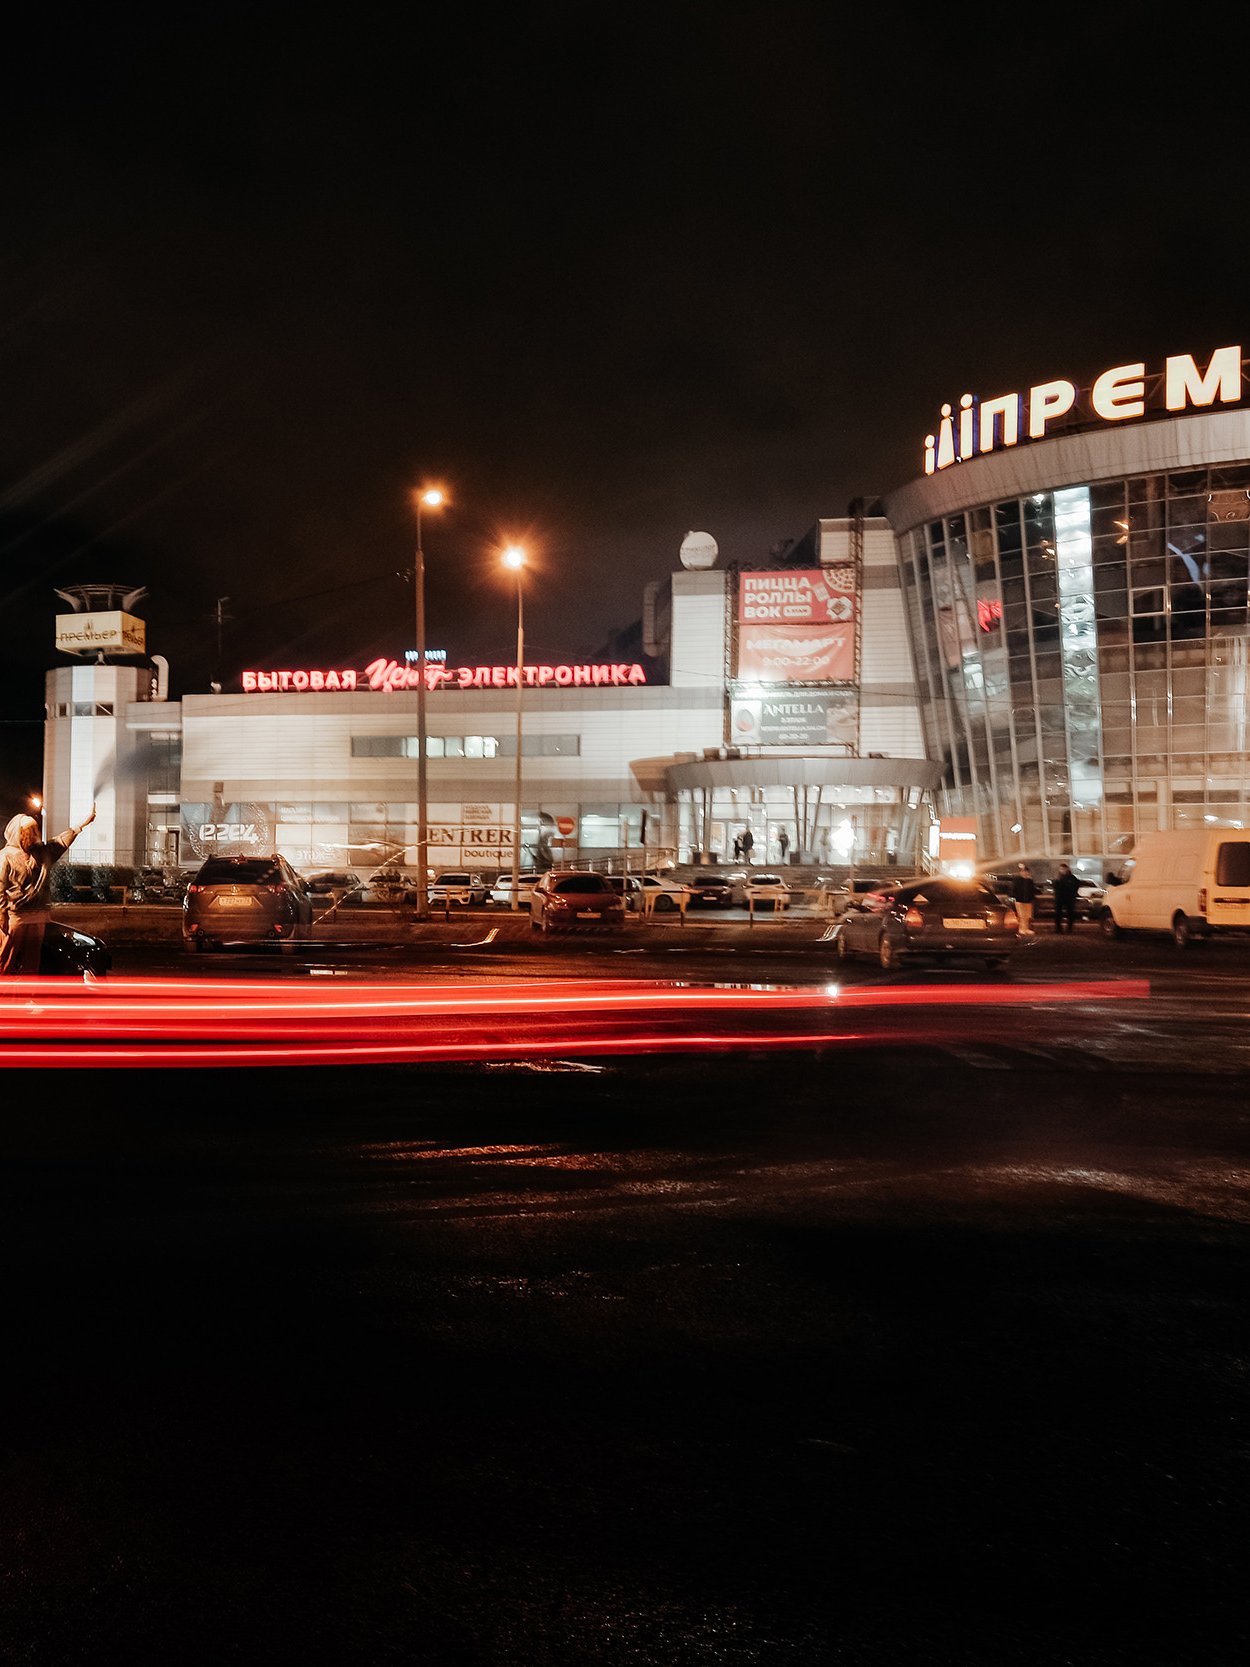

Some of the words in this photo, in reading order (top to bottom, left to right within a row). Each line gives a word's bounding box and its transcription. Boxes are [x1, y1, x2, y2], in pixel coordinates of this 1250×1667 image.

[745, 577, 810, 591] ПИЦЦА
[745, 591, 812, 604] РОЛЛЫ
[744, 606, 781, 618] ВОК
[242, 669, 357, 690] БЫТОВАЯ
[457, 664, 646, 687] ЭЛЕКТРОНИКА
[763, 703, 824, 717] ANTELLA
[464, 849, 514, 861] boutique
